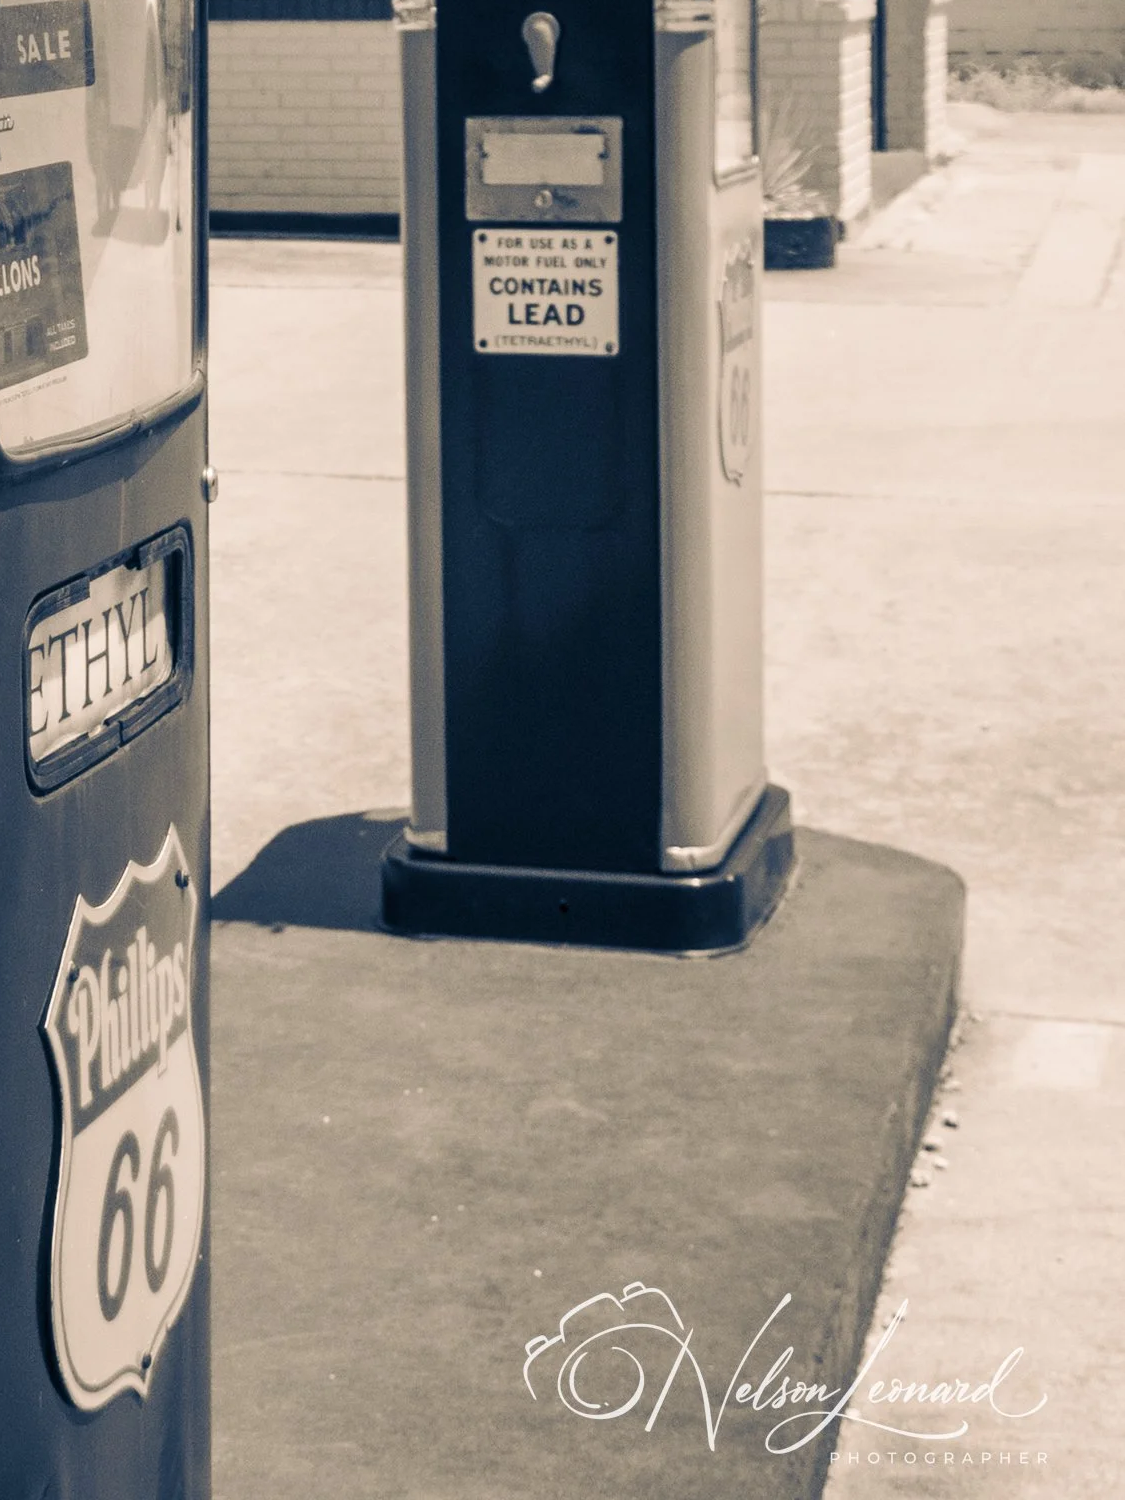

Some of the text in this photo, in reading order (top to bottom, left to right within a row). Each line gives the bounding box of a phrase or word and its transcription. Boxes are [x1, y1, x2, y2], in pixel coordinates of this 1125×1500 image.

[17, 29, 71, 65] SALE
[498, 237, 593, 250] FOR USE AS A
[484, 256, 607, 269] MOTOR FUEL ONLY
[489, 277, 603, 297] CONTAINS
[508, 303, 585, 326] LEAD
[494, 334, 599, 350] (TETRAETHYL)
[28, 586, 159, 737] ETHYL
[68, 925, 186, 1108] Phillips
[97, 1106, 180, 1322] 66
